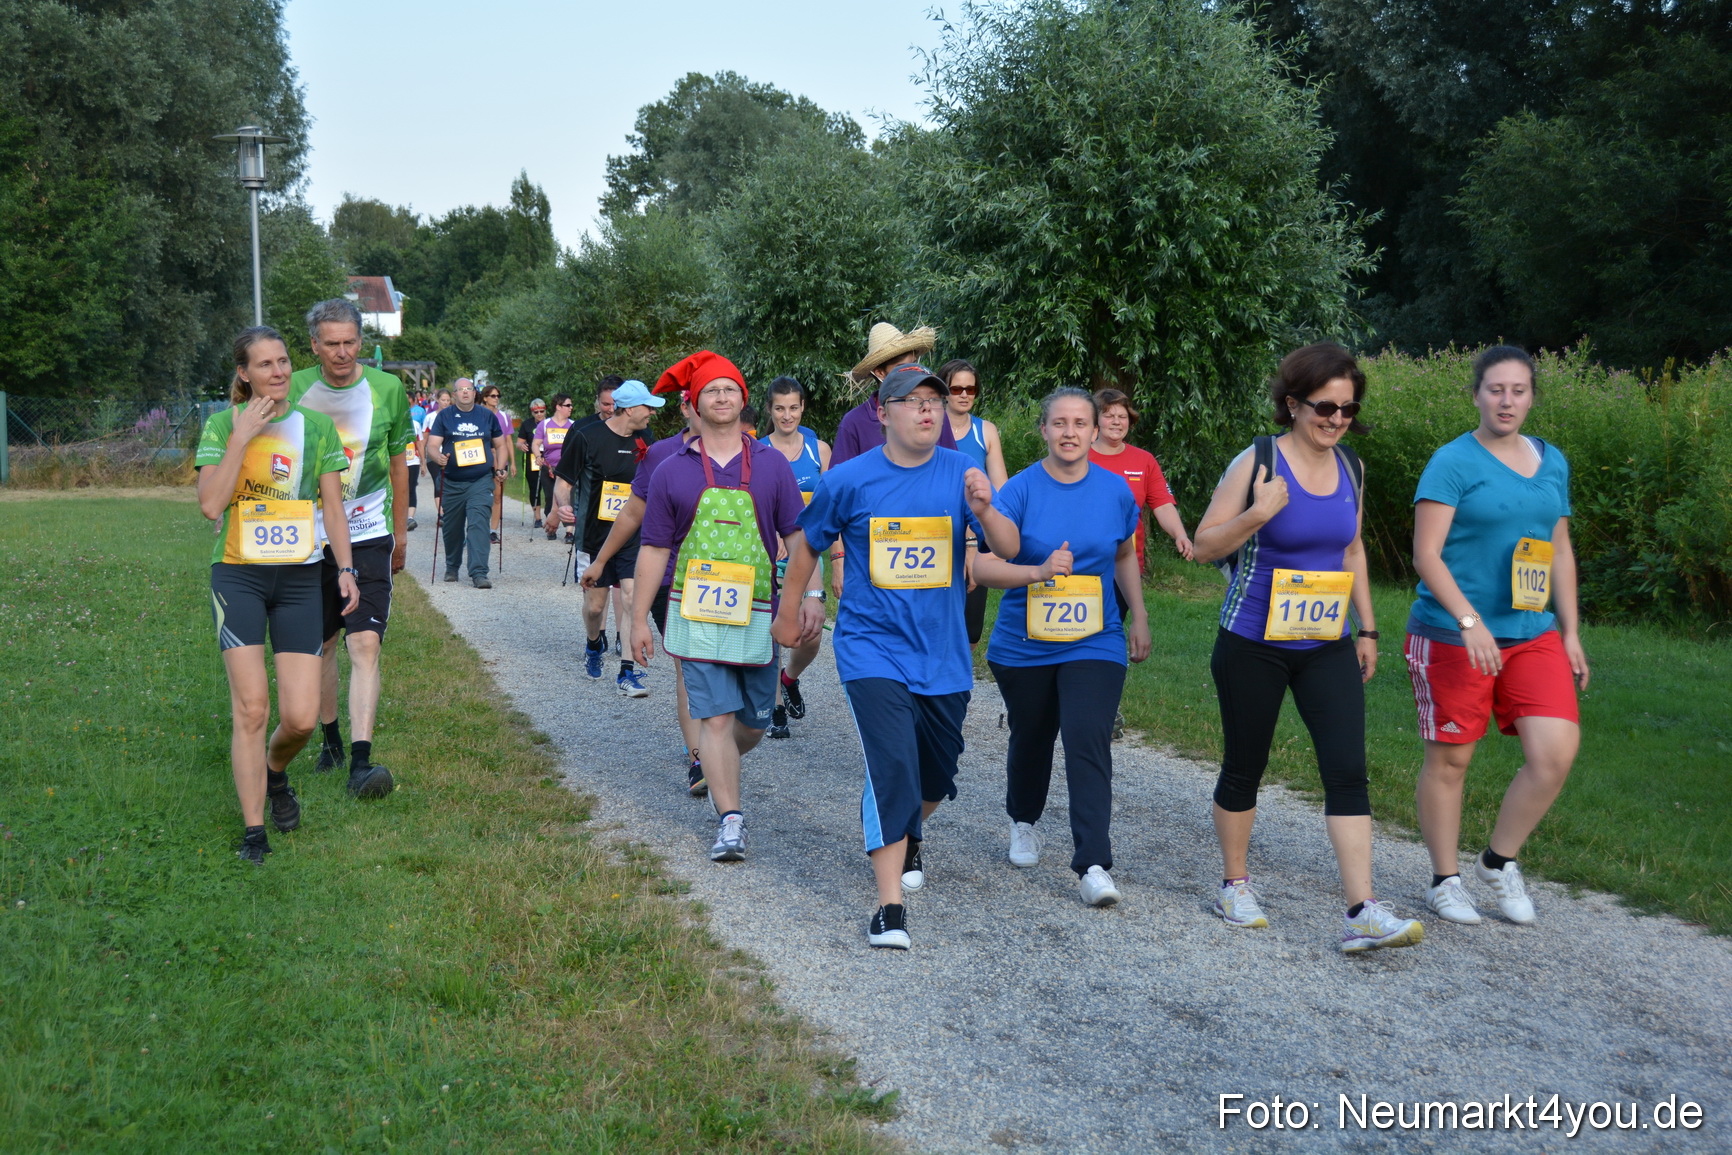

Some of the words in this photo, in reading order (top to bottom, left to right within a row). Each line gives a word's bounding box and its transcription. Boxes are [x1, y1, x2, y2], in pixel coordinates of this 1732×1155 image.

[462, 449, 479, 459] 181
[254, 525, 299, 546] 983
[886, 546, 936, 569] 752
[1517, 566, 1546, 593] 1102
[697, 584, 738, 608] 713
[1042, 602, 1088, 623] 720
[1279, 599, 1340, 622] 1104
